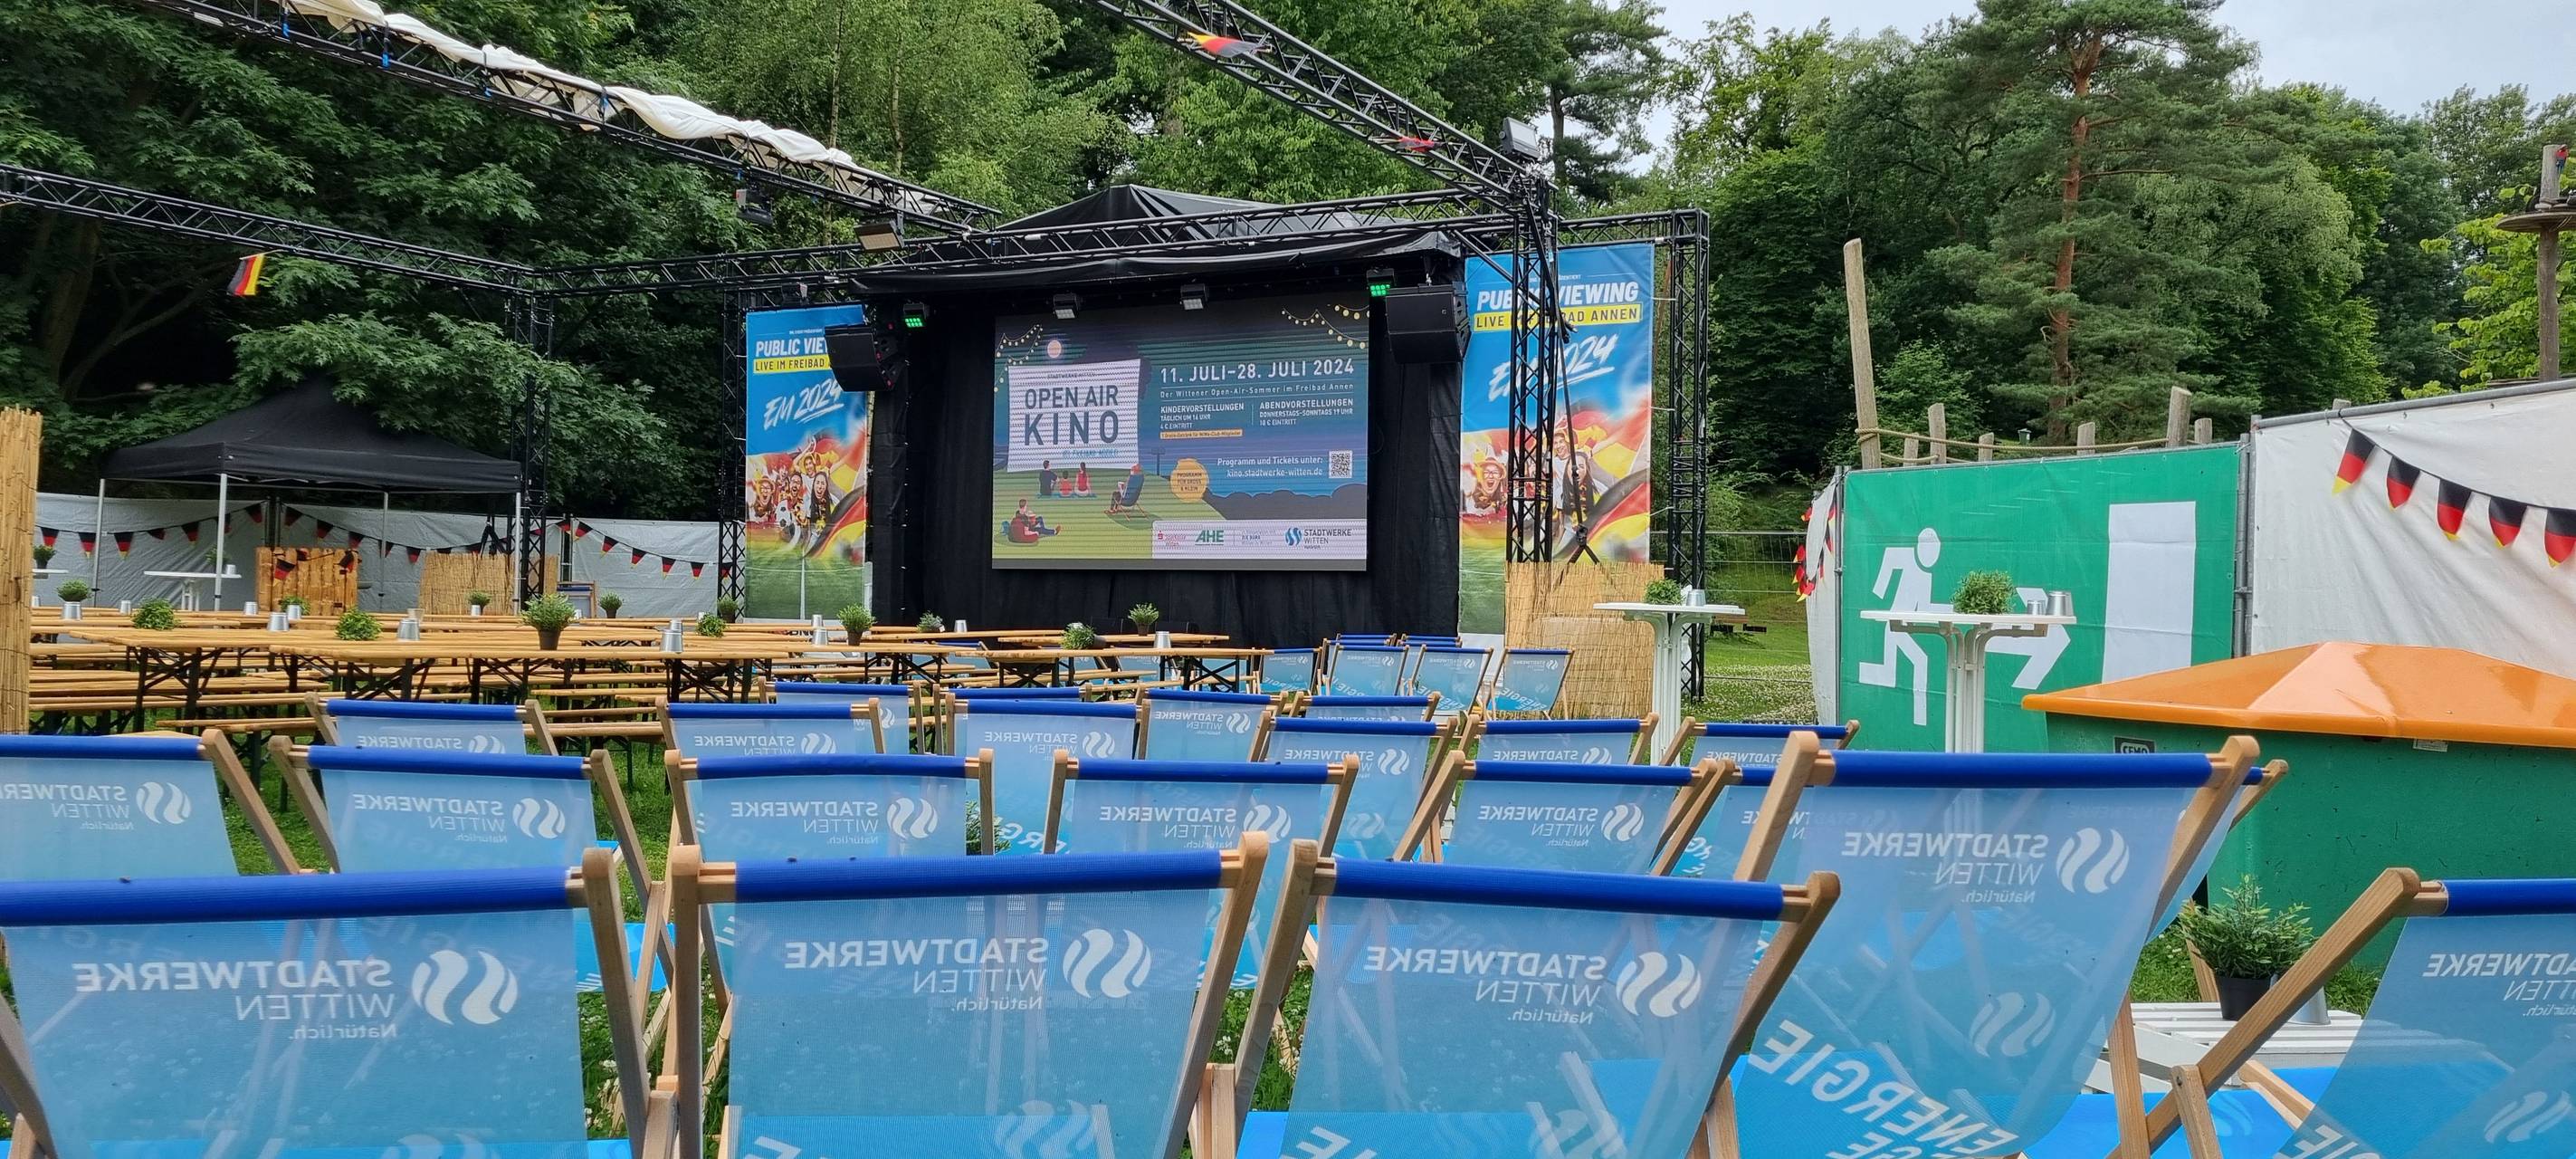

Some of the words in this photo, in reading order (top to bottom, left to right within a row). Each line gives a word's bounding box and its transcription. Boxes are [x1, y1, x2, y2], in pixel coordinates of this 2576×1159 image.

[1476, 315, 1504, 328] LIVE
[1590, 308, 1637, 321] ANNEN
[756, 338, 801, 357] PUBLIC
[755, 360, 774, 371] LIVE
[777, 360, 786, 369] IM
[788, 359, 825, 369] FREIBAD
[1160, 368, 1183, 383] 11.
[1268, 360, 1306, 378] JULI
[1313, 358, 1354, 376] 2024
[1025, 386, 1078, 409] OPEN
[1084, 384, 1119, 407] AIR
[1176, 389, 1208, 398] Wittener
[1160, 402, 1245, 414] KINDERVORSTELLUNGEN
[1260, 398, 1354, 409] ABENDVORSTELLUNGEN
[763, 395, 795, 431] EM
[1025, 410, 1119, 445] KINO
[1216, 457, 1256, 467] Programm
[1256, 456, 1271, 465] und
[1272, 455, 1300, 465] Tickets
[1300, 455, 1323, 464] unter:
[1227, 467, 1323, 478] kino.stadtwerke-witten.de
[1195, 530, 1224, 543] AHE
[1303, 536, 1329, 544] WITTEN
